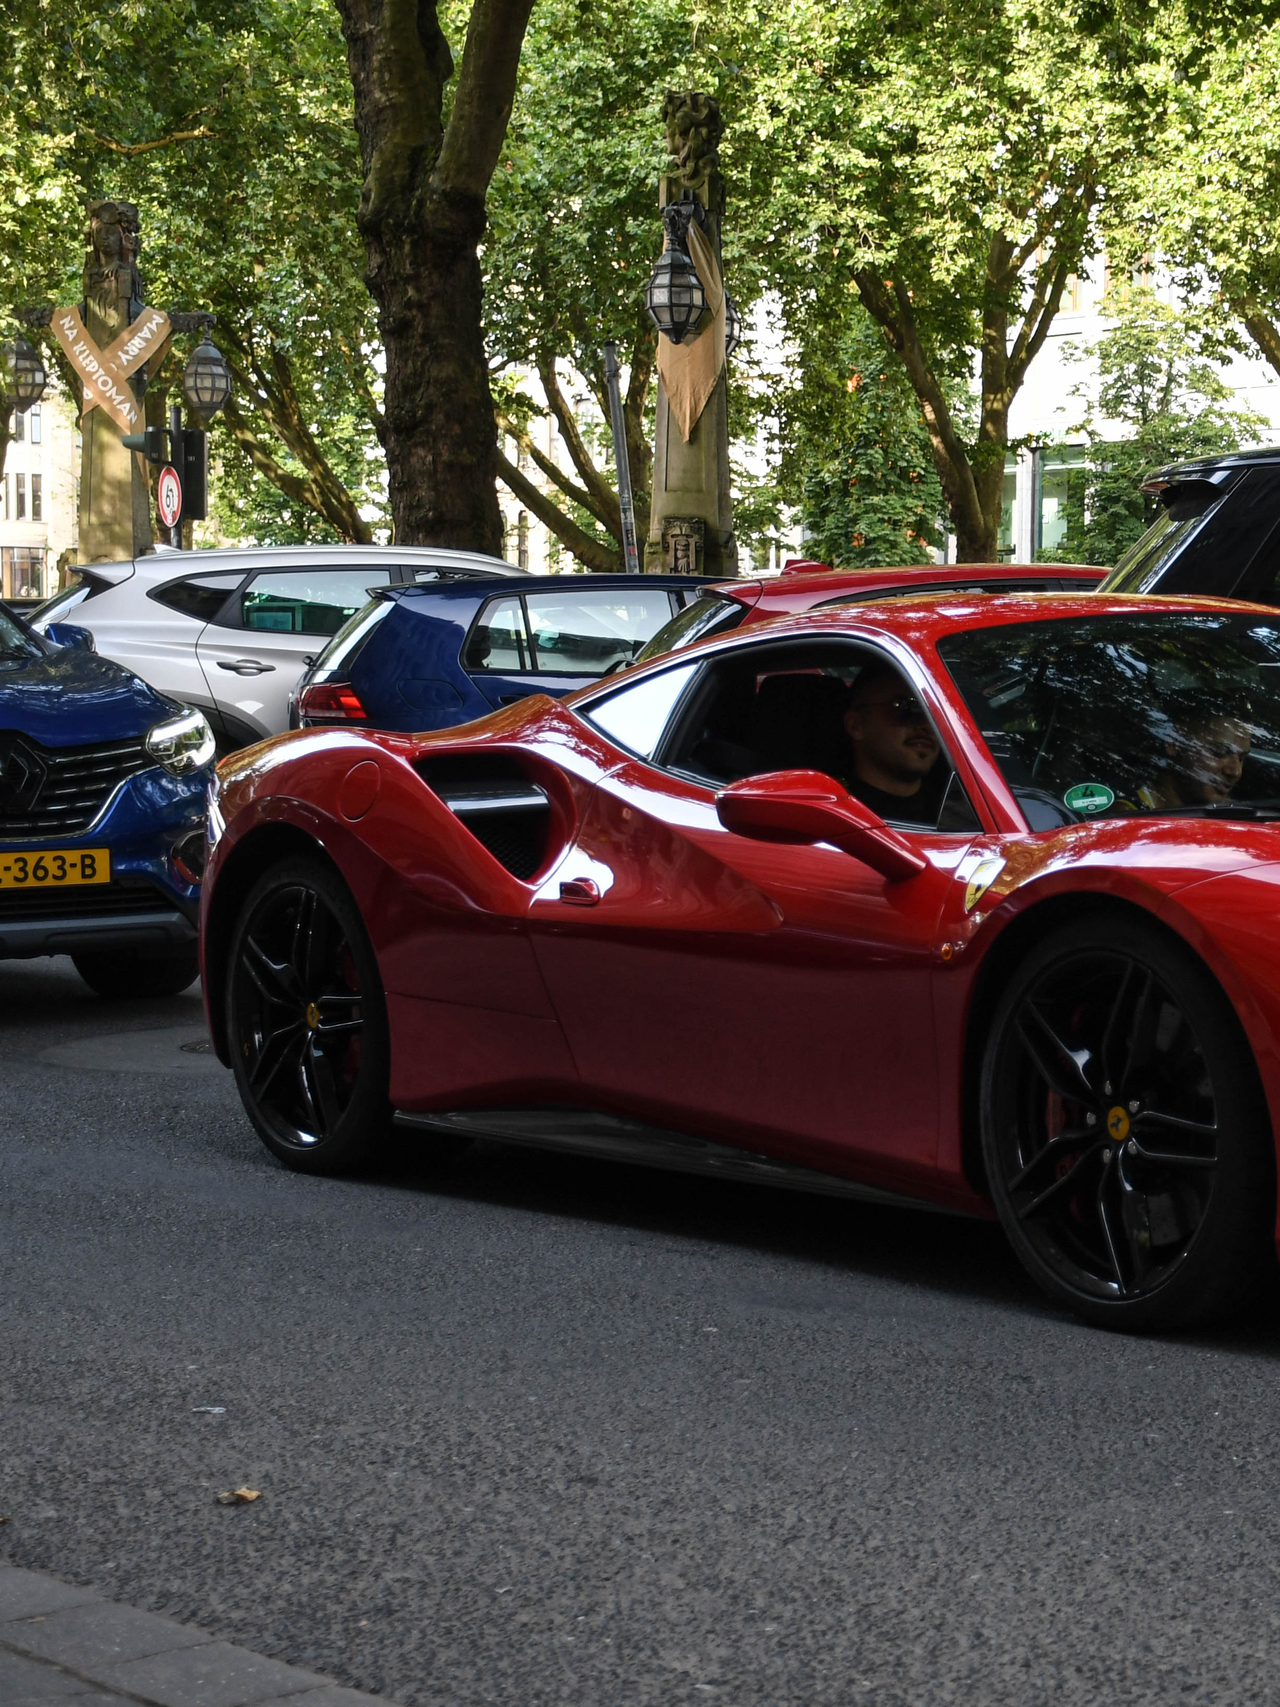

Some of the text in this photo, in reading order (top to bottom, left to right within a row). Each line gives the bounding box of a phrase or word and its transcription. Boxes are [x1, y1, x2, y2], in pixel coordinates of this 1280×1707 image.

[117, 314, 165, 366] MARRY
[60, 315, 138, 424] NA KLEPTOMAN
[1082, 785, 1096, 798] 4
[0, 853, 97, 882] -363-B
